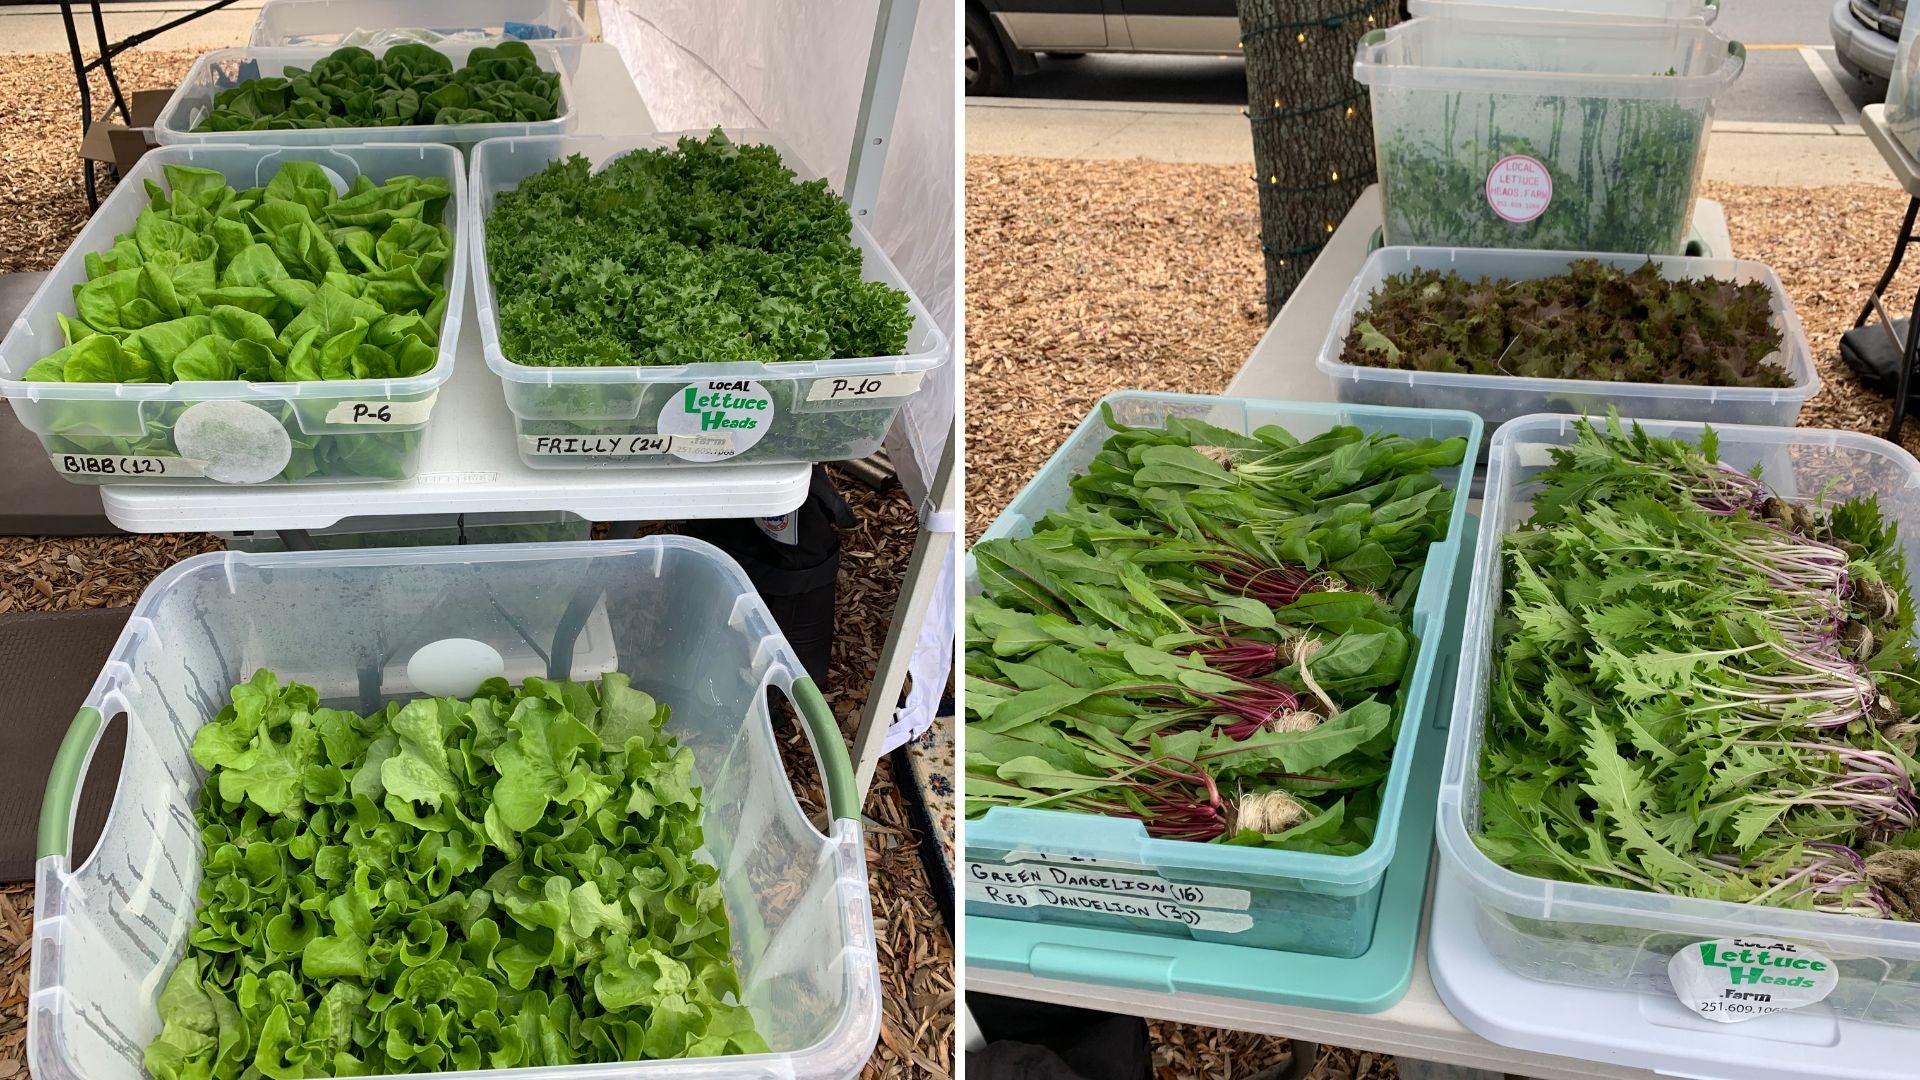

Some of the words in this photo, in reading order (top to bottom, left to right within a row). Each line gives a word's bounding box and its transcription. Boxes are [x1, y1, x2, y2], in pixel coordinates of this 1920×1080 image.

[1505, 162, 1534, 173] LOCAL
[1499, 175, 1540, 186] LETTUCE
[831, 378, 882, 398] P-10
[684, 387, 768, 414] Lettuce
[353, 403, 392, 423] P-6
[701, 410, 758, 431] Heads
[536, 437, 622, 455] FRILLY
[630, 435, 673, 454] (24)
[970, 863, 1041, 883] GREEN
[985, 886, 1028, 906] RED
[1038, 888, 1150, 917] DANDELION
[1699, 943, 1828, 972] Lettuce
[1729, 966, 1816, 988] Heads
